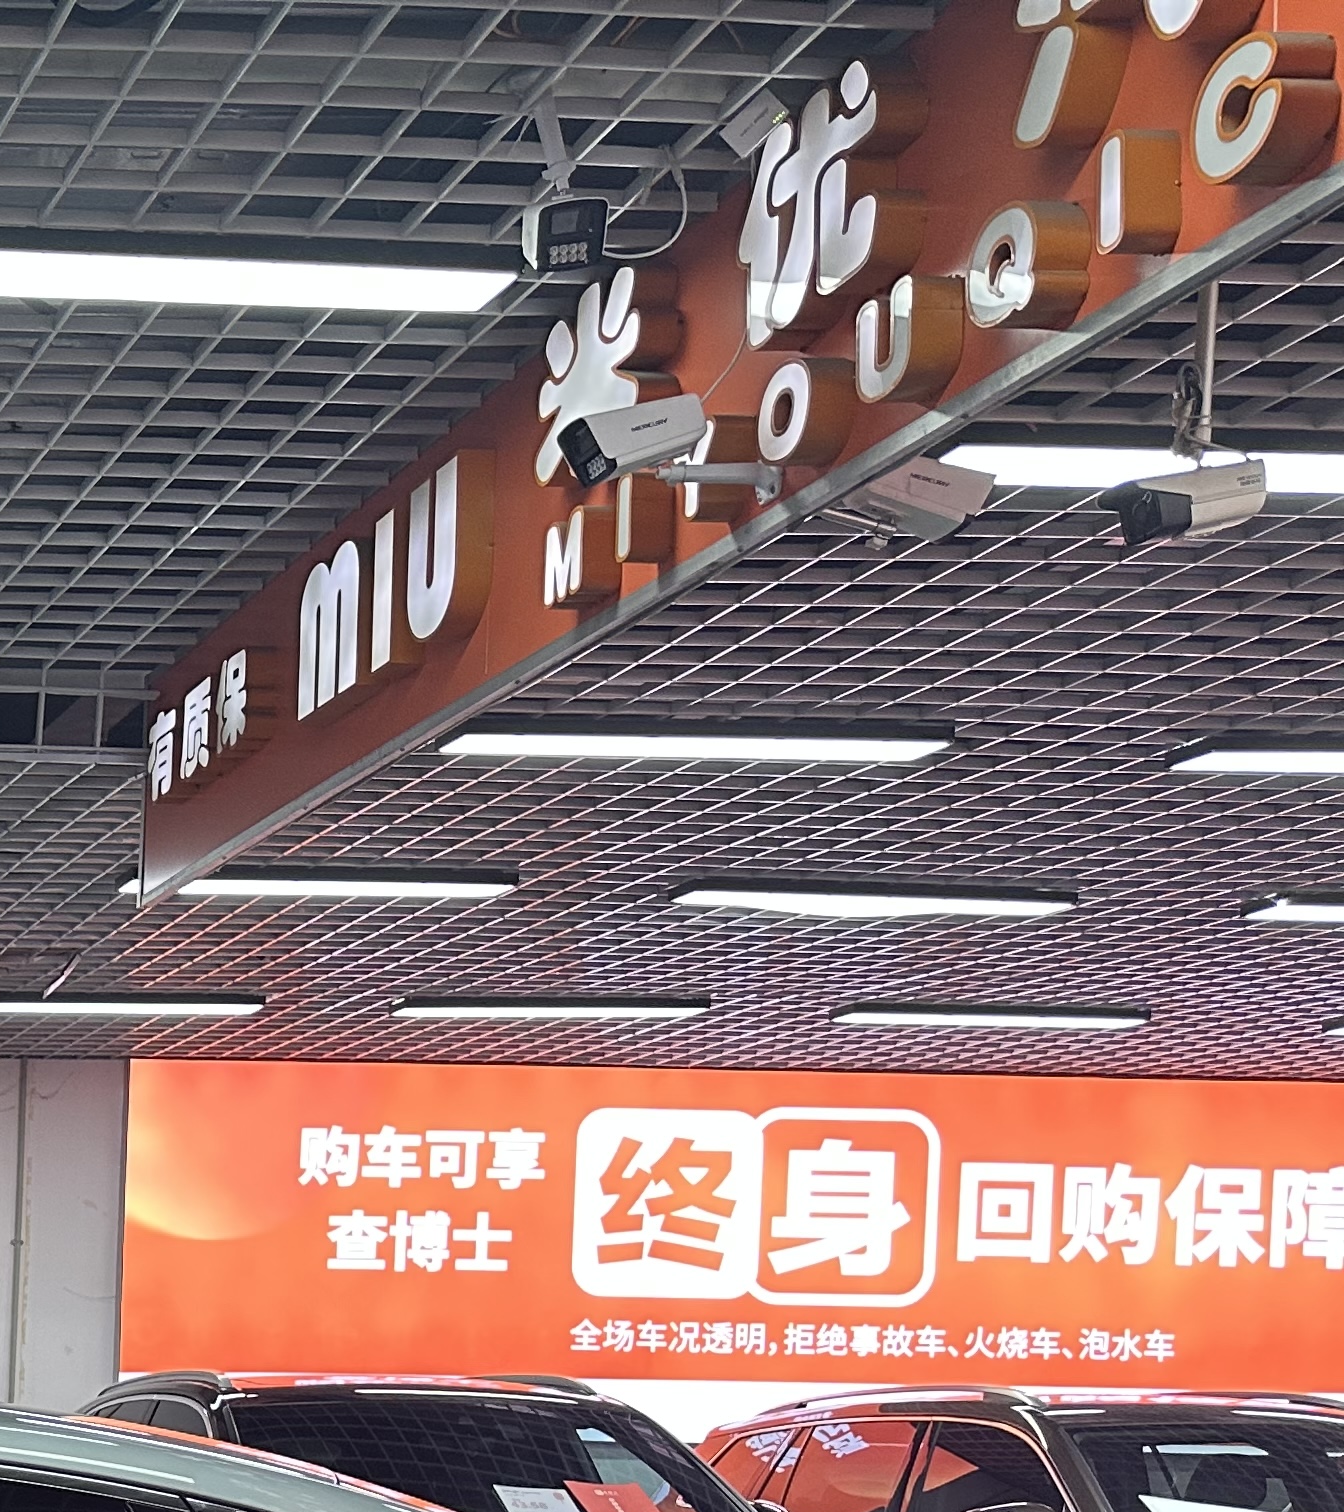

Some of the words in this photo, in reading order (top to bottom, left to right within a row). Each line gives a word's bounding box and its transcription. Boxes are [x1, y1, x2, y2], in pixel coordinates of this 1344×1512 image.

[536, 0, 1204, 486] 米优
[297, 455, 458, 720] MIU
[298, 1125, 546, 1189] 购车可享
[597, 1136, 911, 1277] 终身
[956, 1161, 1344, 1270] 回购保障
[326, 1209, 513, 1273] 查博士
